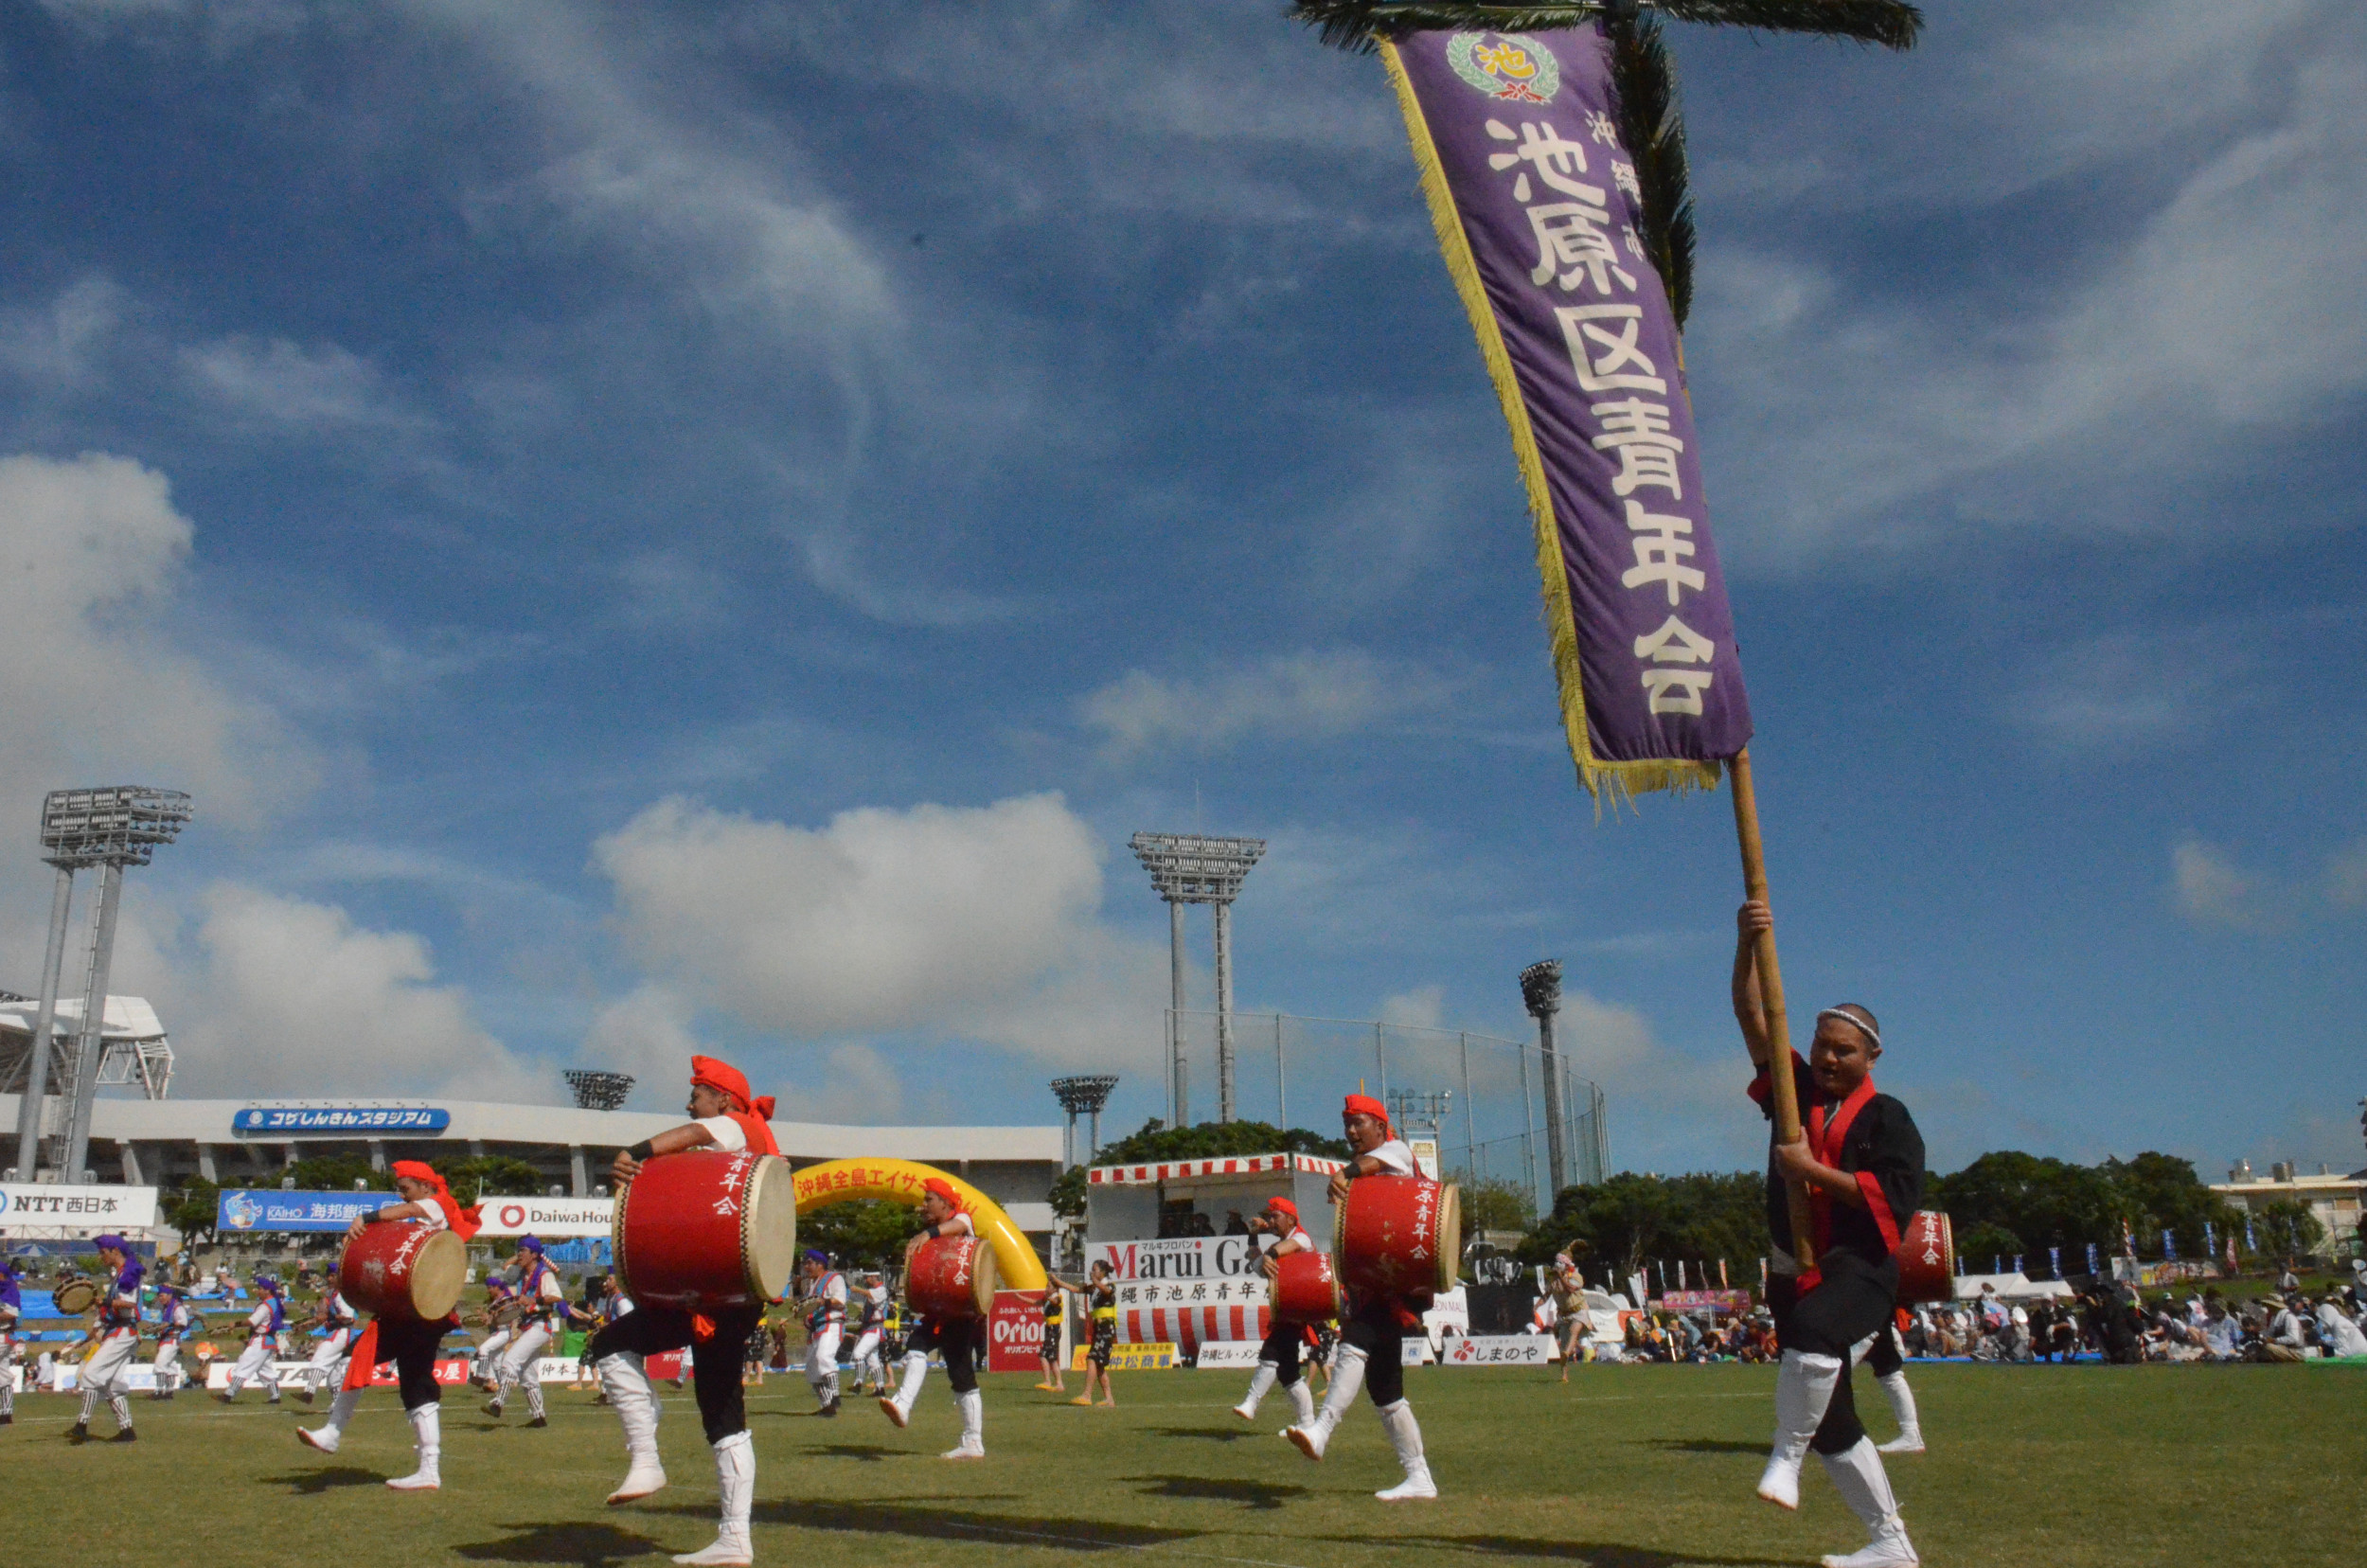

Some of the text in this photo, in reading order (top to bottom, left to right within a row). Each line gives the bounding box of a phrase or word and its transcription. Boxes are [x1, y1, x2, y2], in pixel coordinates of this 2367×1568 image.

[1474, 42, 1536, 79] 池
[1485, 118, 1715, 717] 池原区青年会
[269, 1111, 432, 1126] コザしんきんスタジアム
[531, 1209, 579, 1223] Daiwa
[1105, 1240, 1204, 1279] Marui
[1476, 1345, 1539, 1362] しまのや
